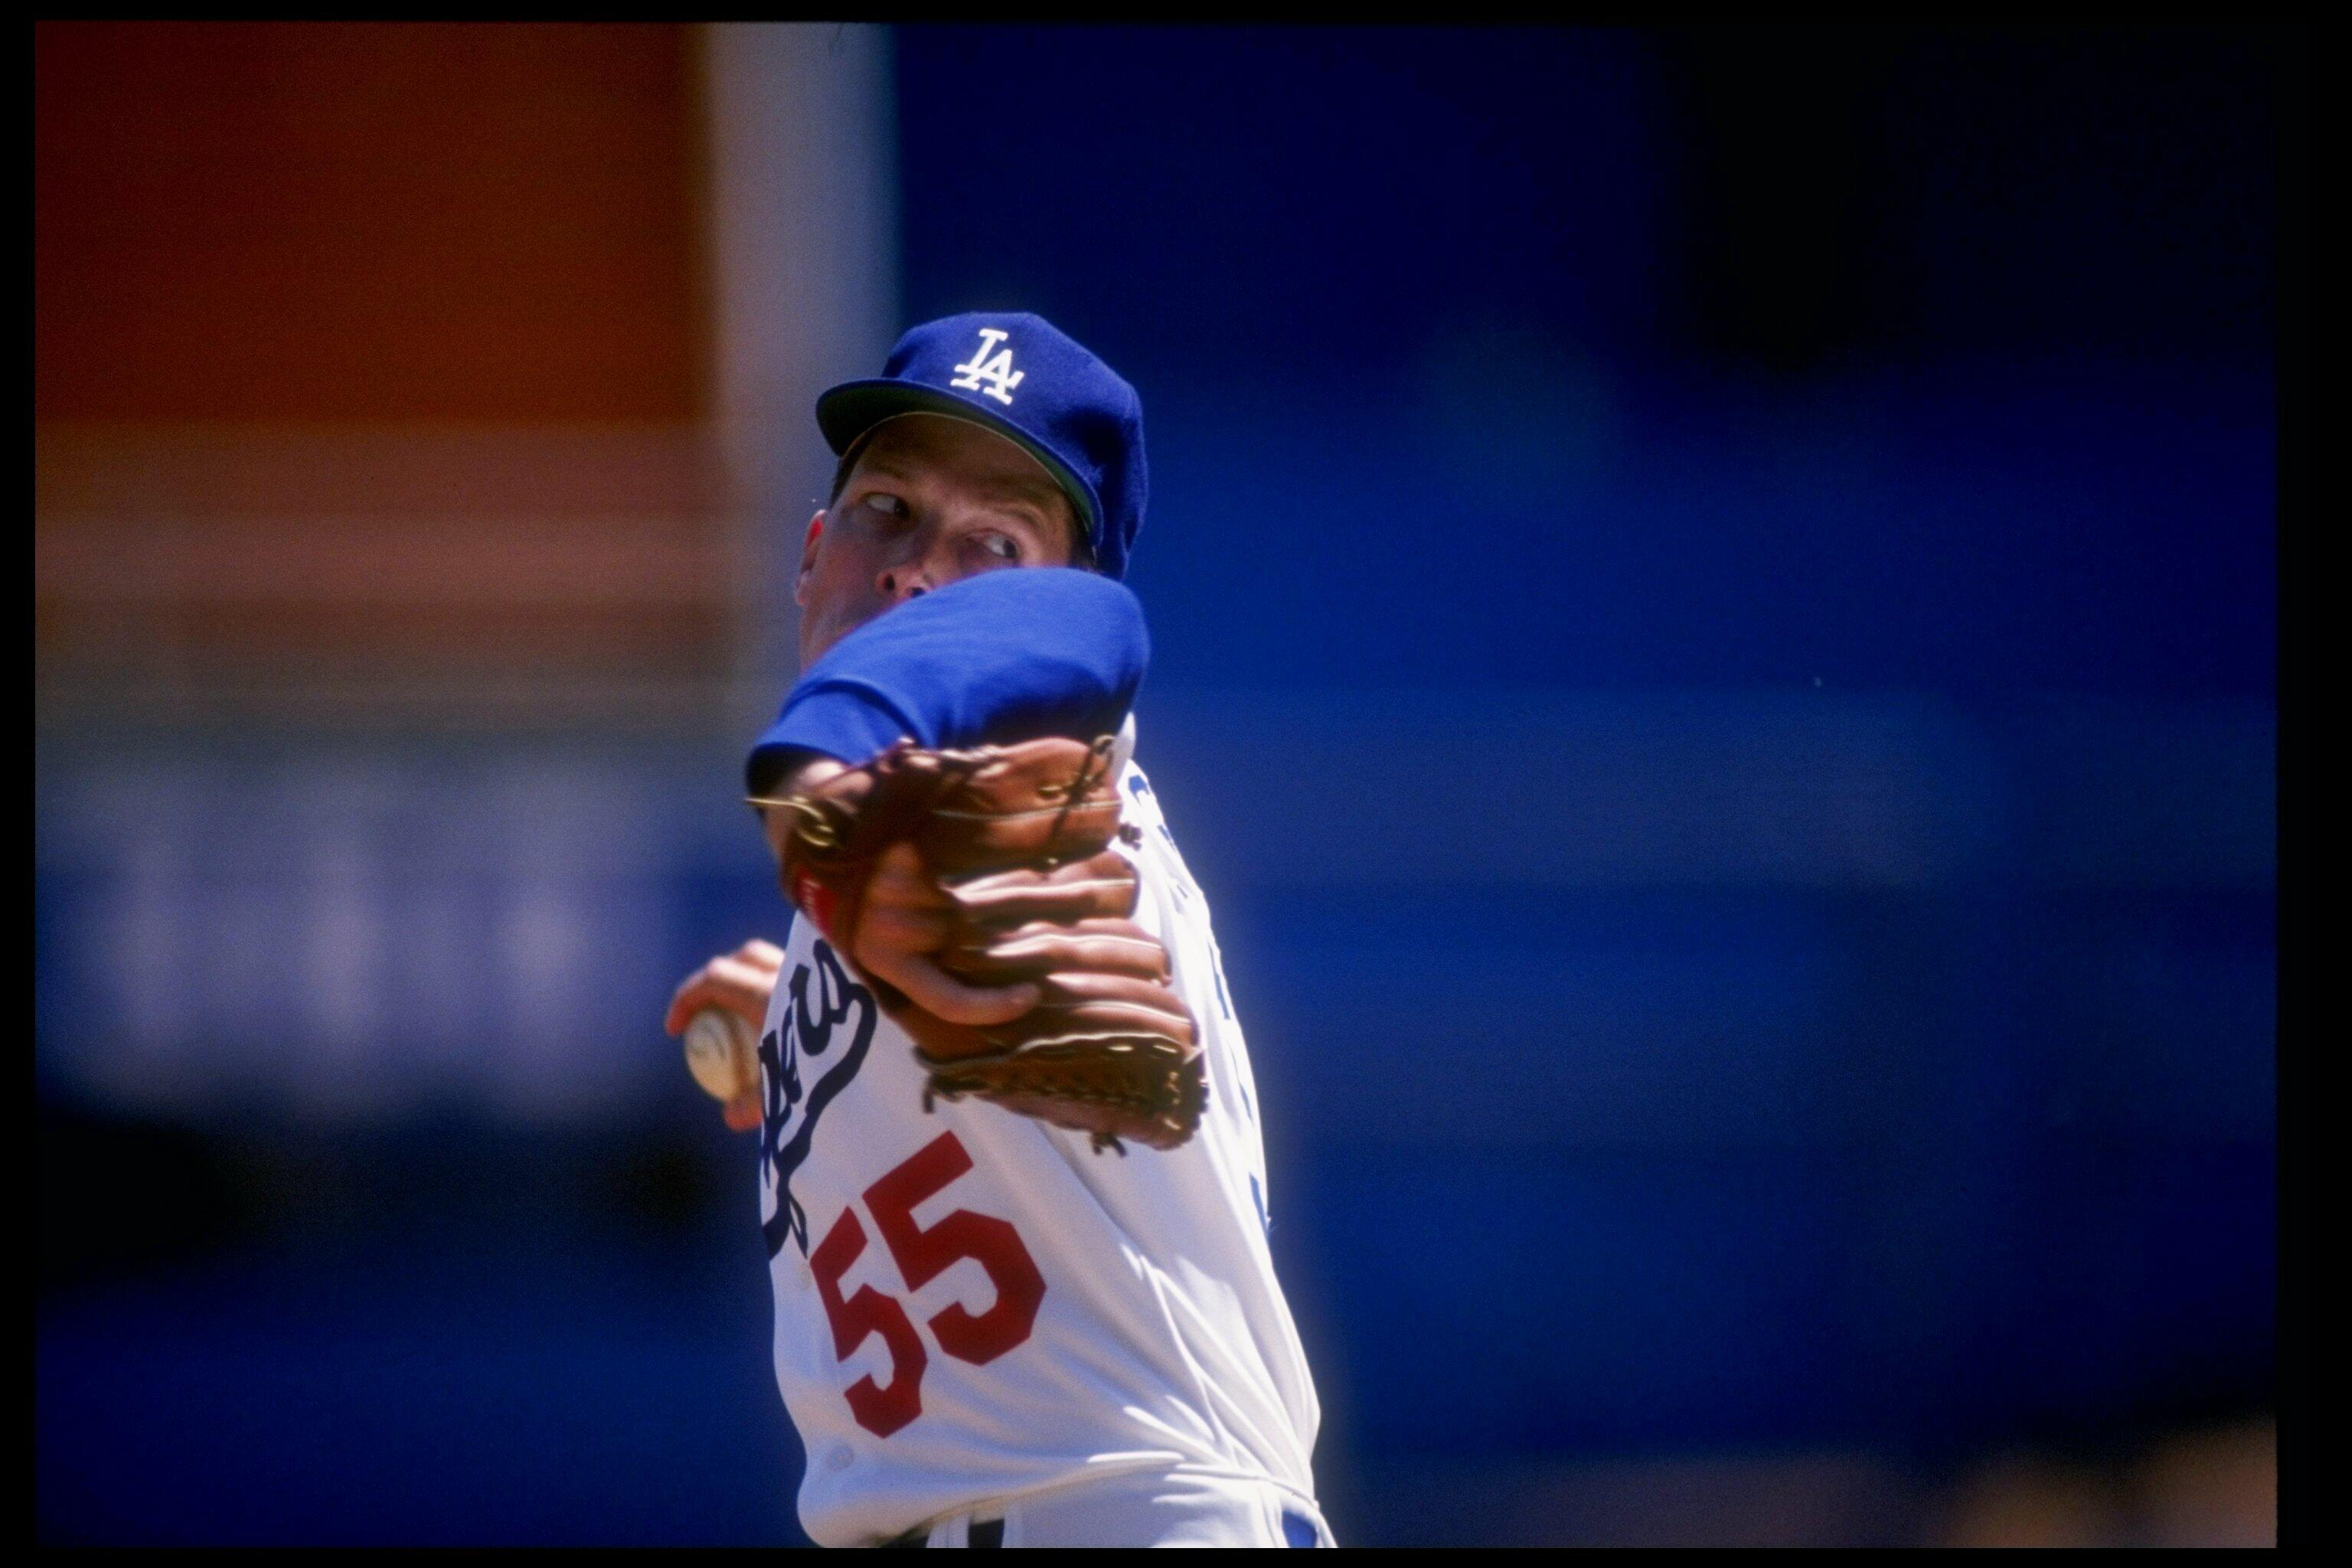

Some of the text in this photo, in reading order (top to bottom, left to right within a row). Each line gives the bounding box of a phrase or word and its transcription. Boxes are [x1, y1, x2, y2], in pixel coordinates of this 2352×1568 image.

[949, 328, 1025, 406] LA
[758, 939, 877, 1210] gers
[809, 1130, 1047, 1439] 55
